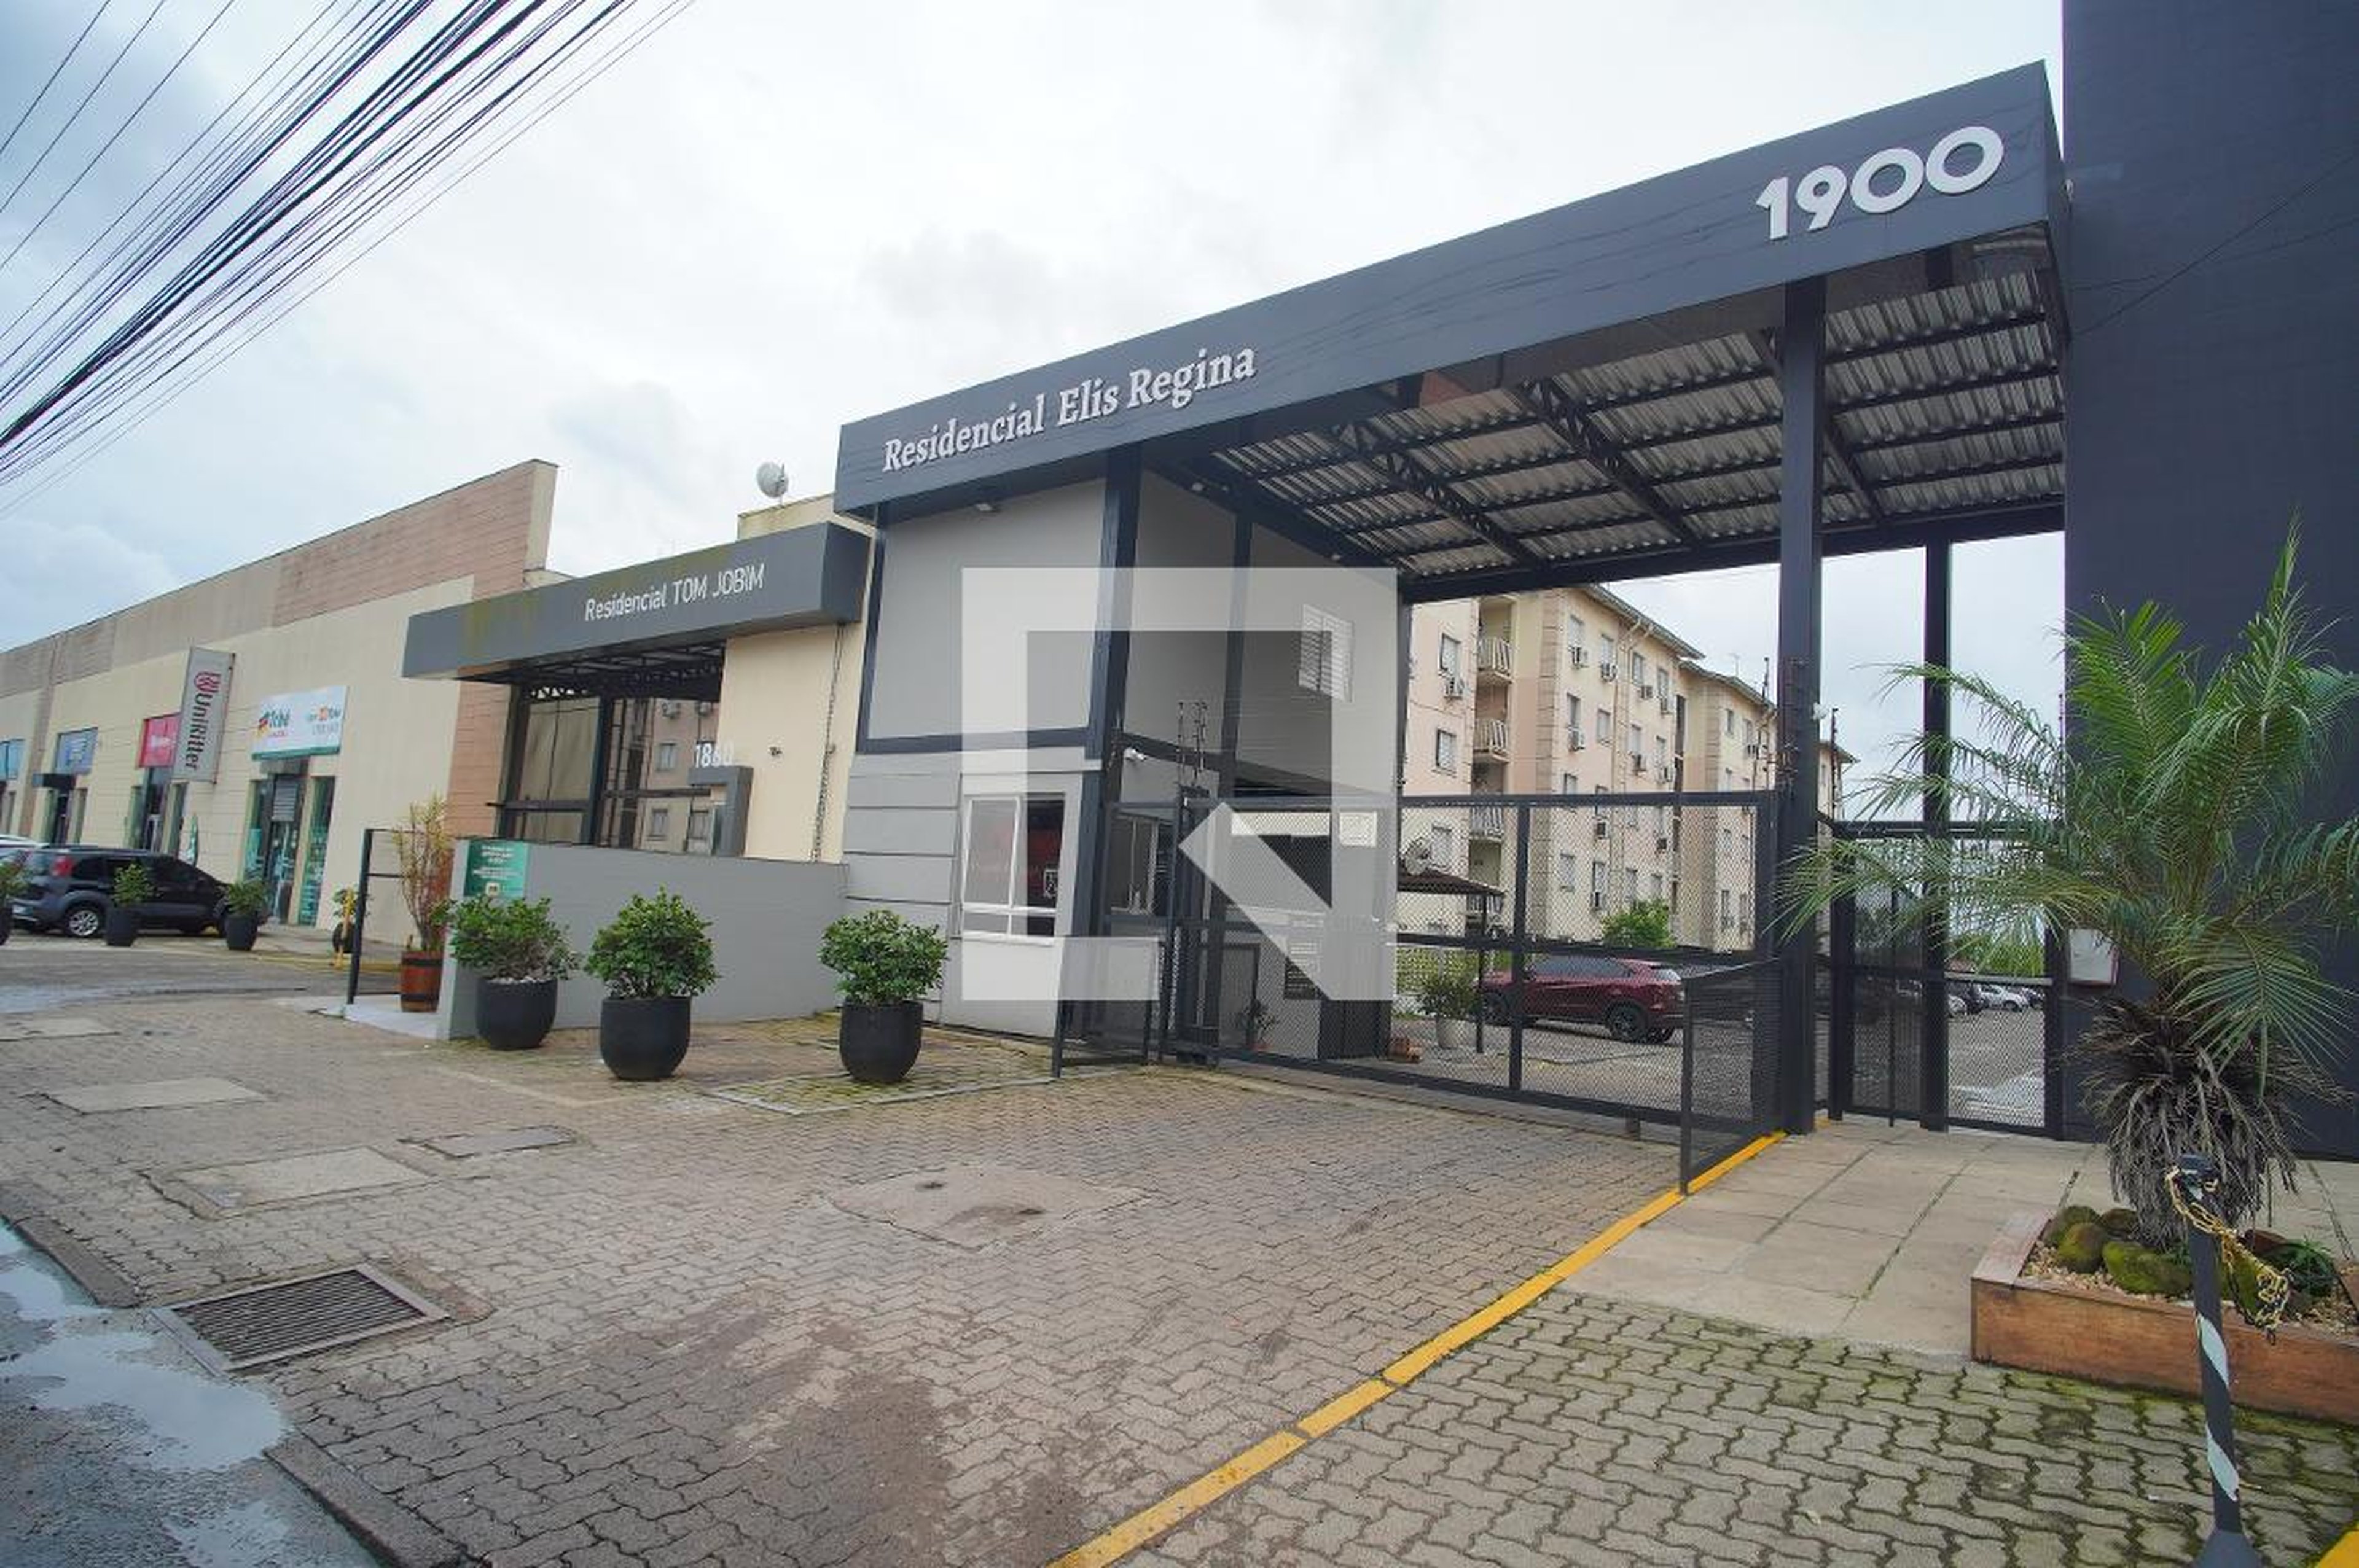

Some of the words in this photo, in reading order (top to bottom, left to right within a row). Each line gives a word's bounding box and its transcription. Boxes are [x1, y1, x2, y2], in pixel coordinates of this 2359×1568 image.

[1756, 125, 2005, 240] 1900
[882, 392, 1046, 472] Residencial
[1057, 376, 1120, 427] Elis
[1126, 347, 1256, 409] Regina
[585, 583, 667, 622] Residencial
[673, 574, 708, 605] TOM
[713, 563, 765, 598] JOBIM
[186, 692, 213, 770] UniRitter
